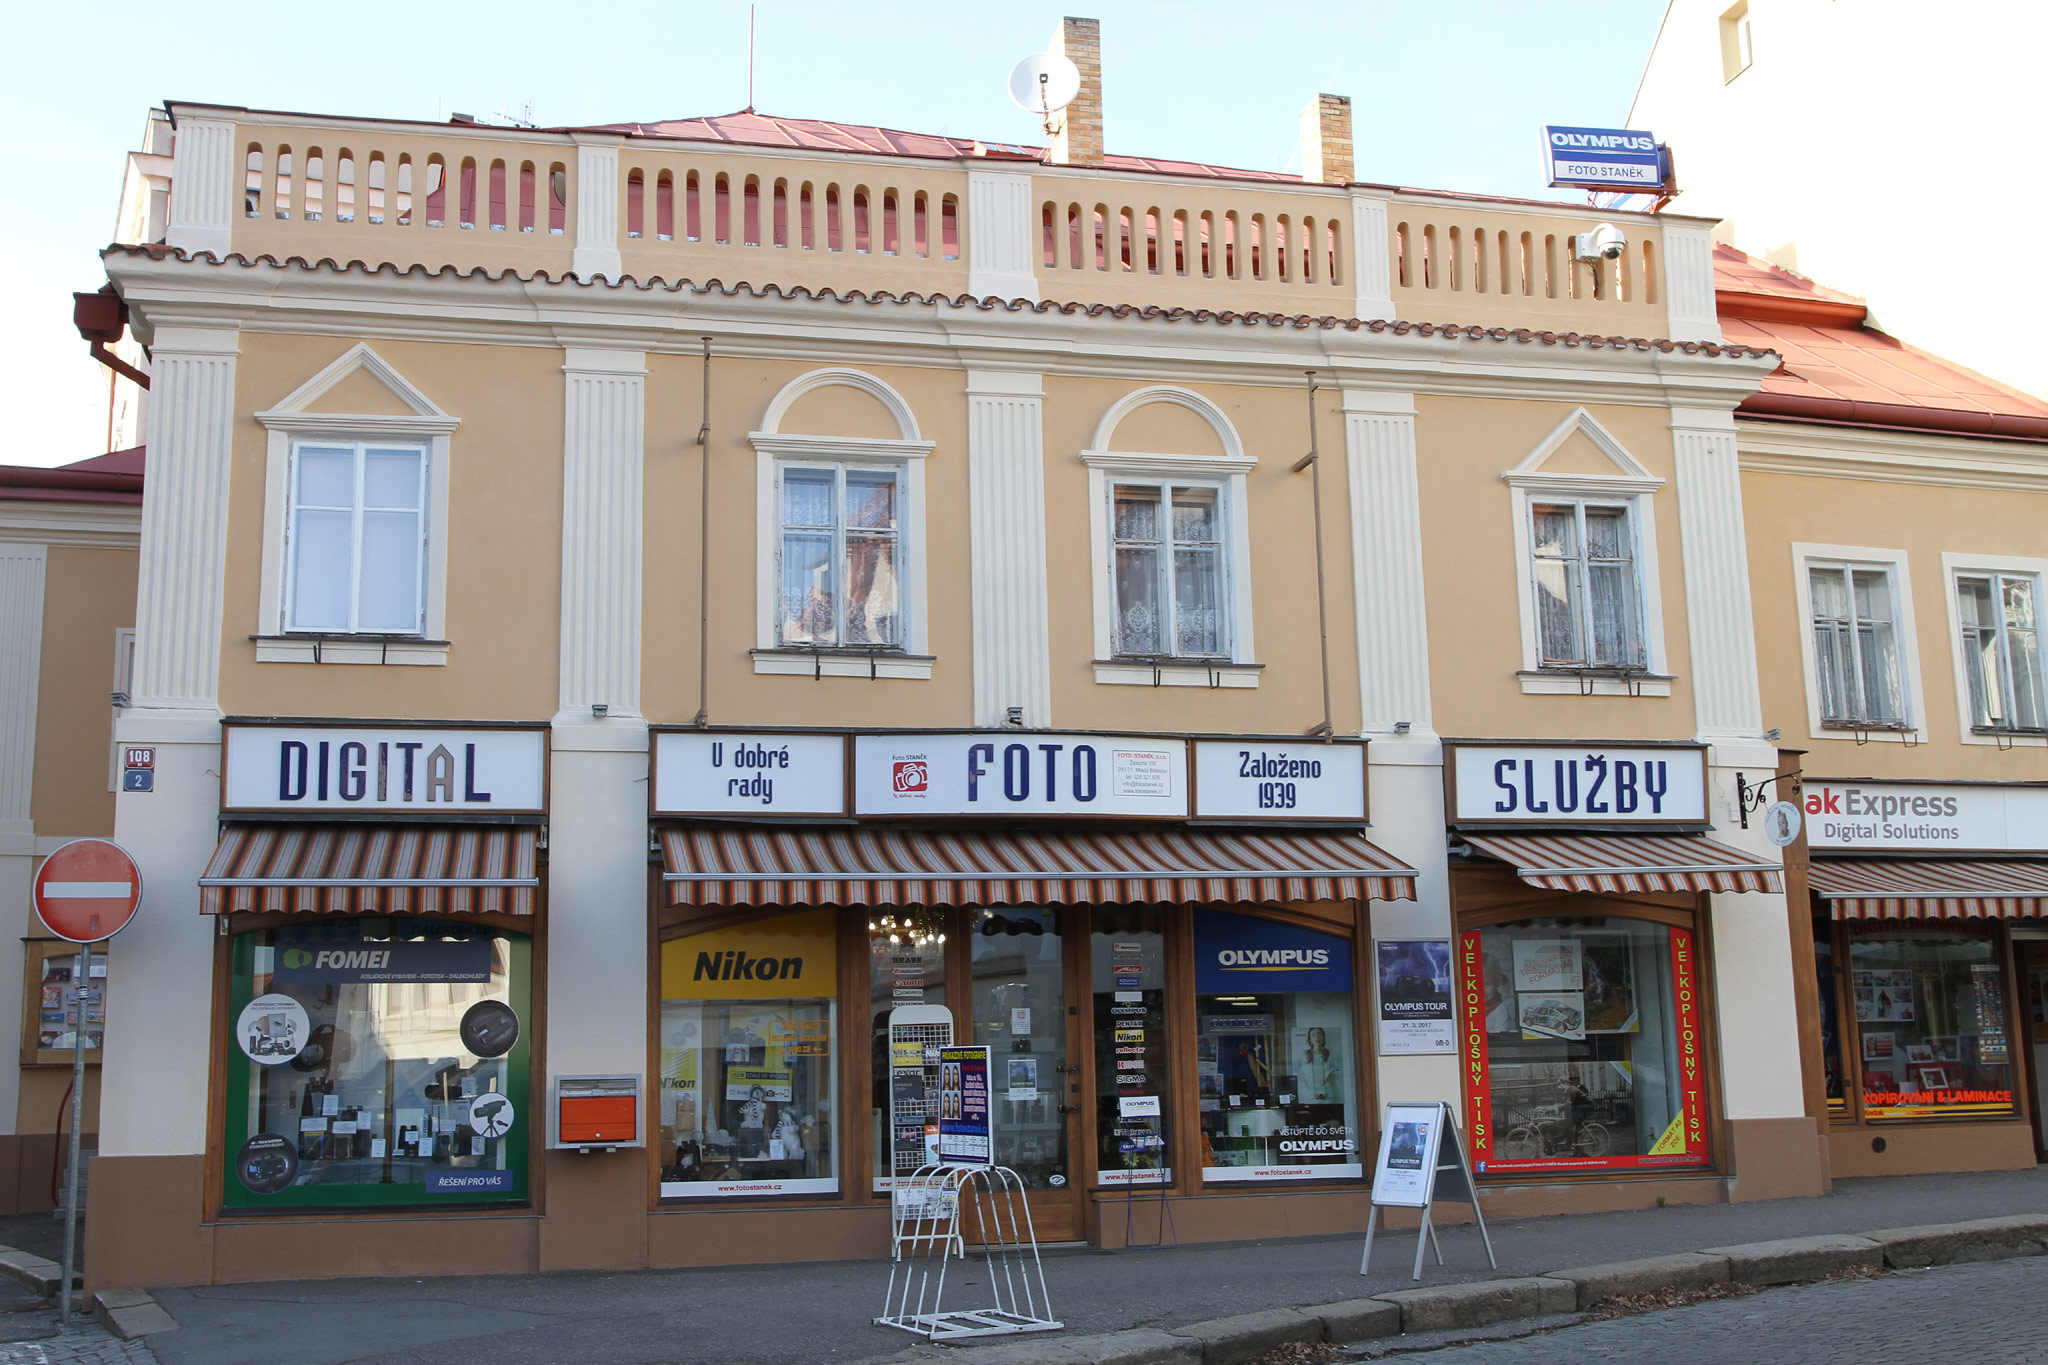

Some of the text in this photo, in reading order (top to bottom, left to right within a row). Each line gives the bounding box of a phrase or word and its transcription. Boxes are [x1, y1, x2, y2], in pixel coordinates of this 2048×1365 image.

[1551, 132, 1654, 150] OLYMPUS
[1568, 165, 1644, 178] FOTO STANĚK
[129, 750, 150, 763] 108
[712, 742, 789, 769] U dobré
[279, 741, 491, 802] DIGITAL
[968, 743, 1097, 802] FOTO
[1239, 750, 1322, 779] Založeno
[135, 774, 142, 787] 2
[728, 771, 773, 805] rady
[1495, 753, 1667, 814] SLUŽBY
[1258, 782, 1297, 809] 1939
[1845, 789, 1958, 822] Express
[1824, 823, 1959, 842] Digital Solutions
[315, 950, 391, 969] FOMEI
[693, 950, 803, 981] Nikon
[892, 956, 923, 964] BRAUN
[1218, 949, 1329, 966] OLYMPUS
[892, 979, 924, 987] Canon
[1384, 1002, 1448, 1011] OLYMPUS TOUR
[1210, 1018, 1267, 1028] OLYMPUS
[1117, 1033, 1142, 1041] Nikon
[1464, 938, 1486, 1150] VELKOPLOŠNÝ TISK
[1675, 937, 1702, 1143] VELKOPLOŠNÝ TISK
[1116, 1074, 1146, 1083] SIGMA
[1864, 1088, 2012, 1105] KOPÍROVÁNÍ & LAMINACE
[1279, 1125, 1354, 1136] VSTUPTE DO SVĚTA
[1279, 1139, 1355, 1152] OLYMPUS
[1669, 1135, 1681, 1149] ZDE
[438, 1175, 502, 1187] ŘEŠENÍ PRO VÁS
[1254, 1168, 1313, 1178] www.fotostanek.cz
[718, 1183, 783, 1192] www.fotostanek.cz
